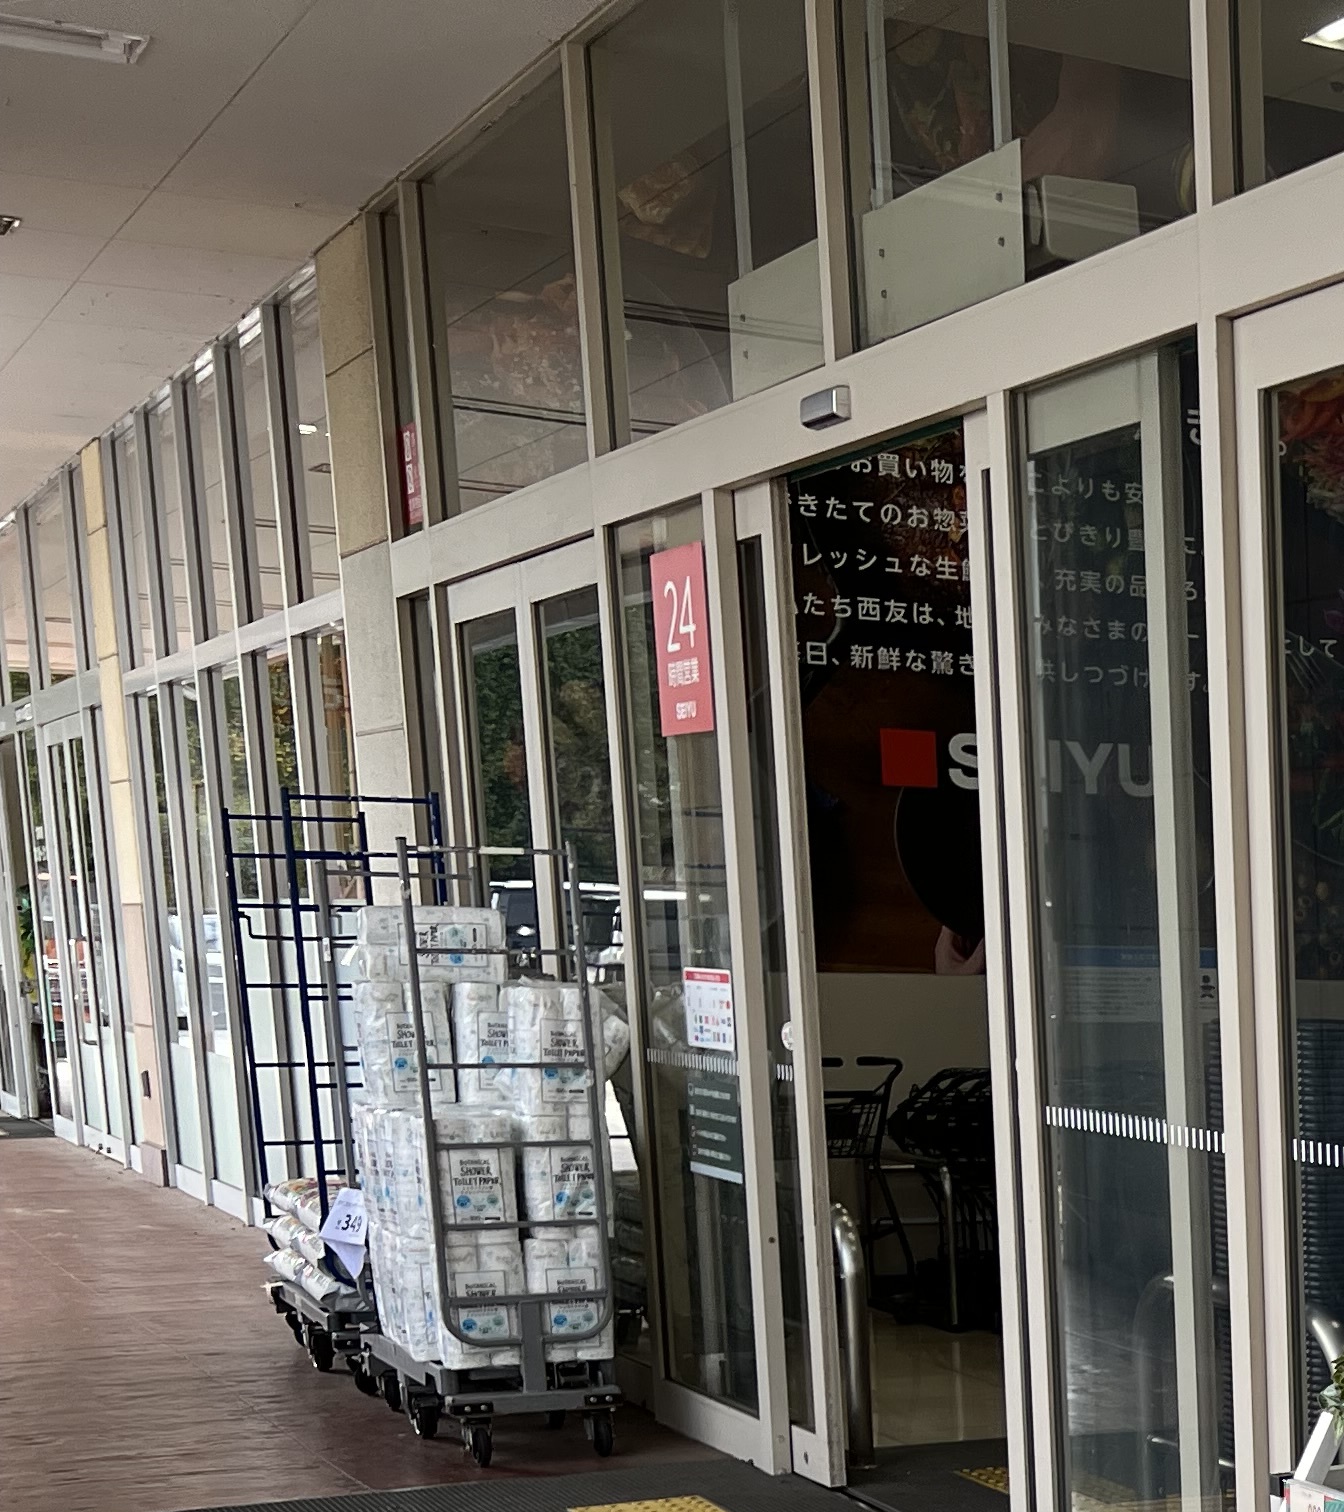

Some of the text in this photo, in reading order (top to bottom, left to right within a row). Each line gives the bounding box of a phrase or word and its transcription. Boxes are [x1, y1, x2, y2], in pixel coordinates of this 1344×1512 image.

[663, 575, 697, 653] 24
[796, 592, 973, 629] たち西友は、地
[797, 641, 975, 676] 日、新鮮な驚き
